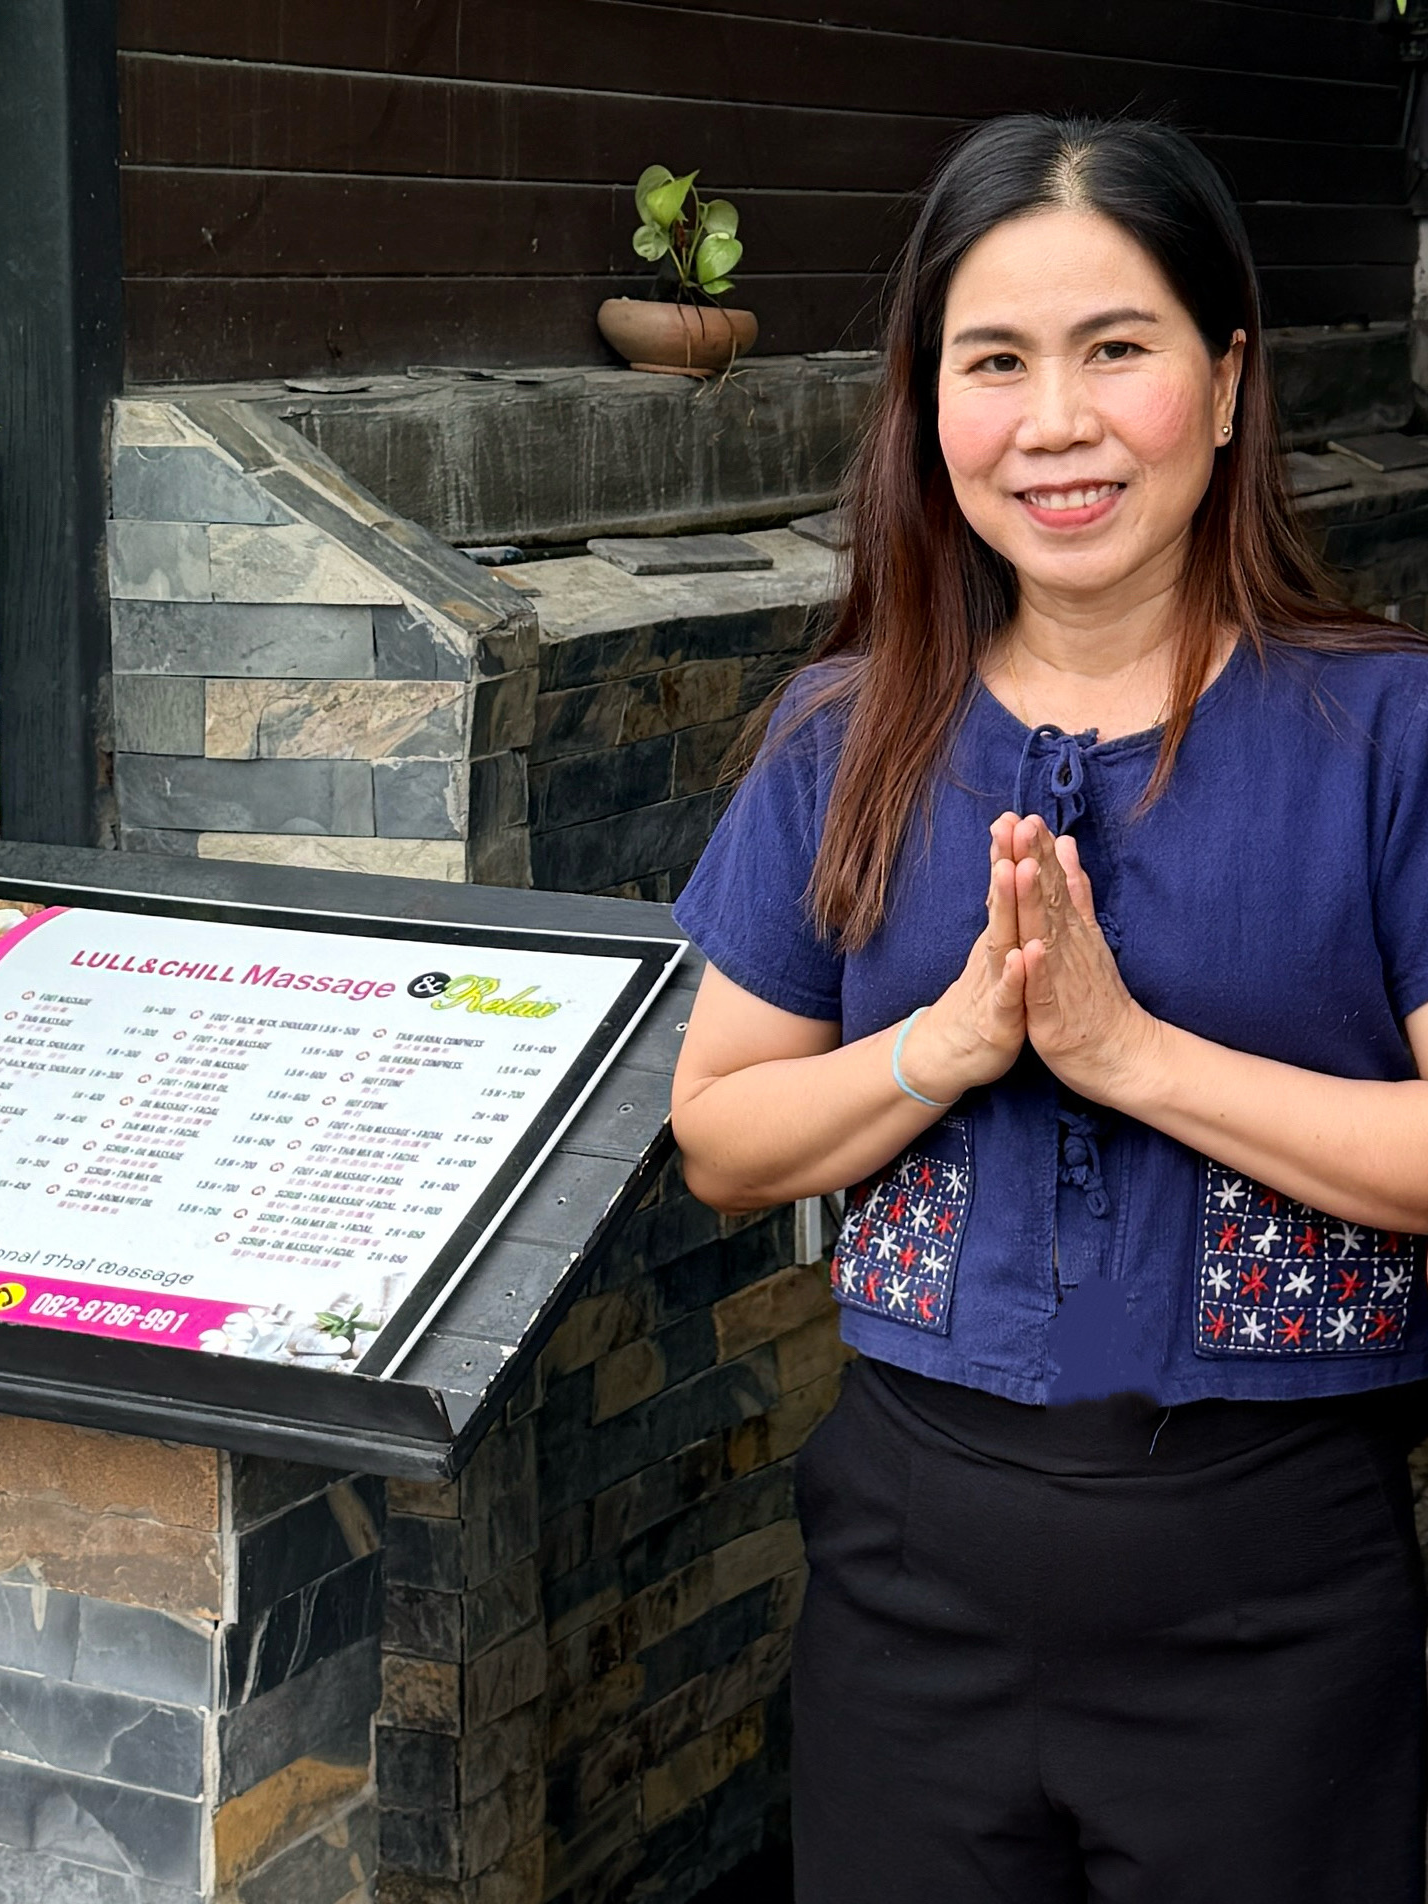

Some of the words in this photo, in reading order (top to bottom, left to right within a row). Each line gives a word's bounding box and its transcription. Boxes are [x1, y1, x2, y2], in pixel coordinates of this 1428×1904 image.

[70, 949, 234, 983] LULL&CHILL
[239, 962, 397, 1001] Massage
[430, 974, 562, 1019] Relax
[44, 1253, 96, 1272] Thai
[96, 1260, 194, 1288] Massage
[29, 1292, 190, 1334] 082-8786-991
